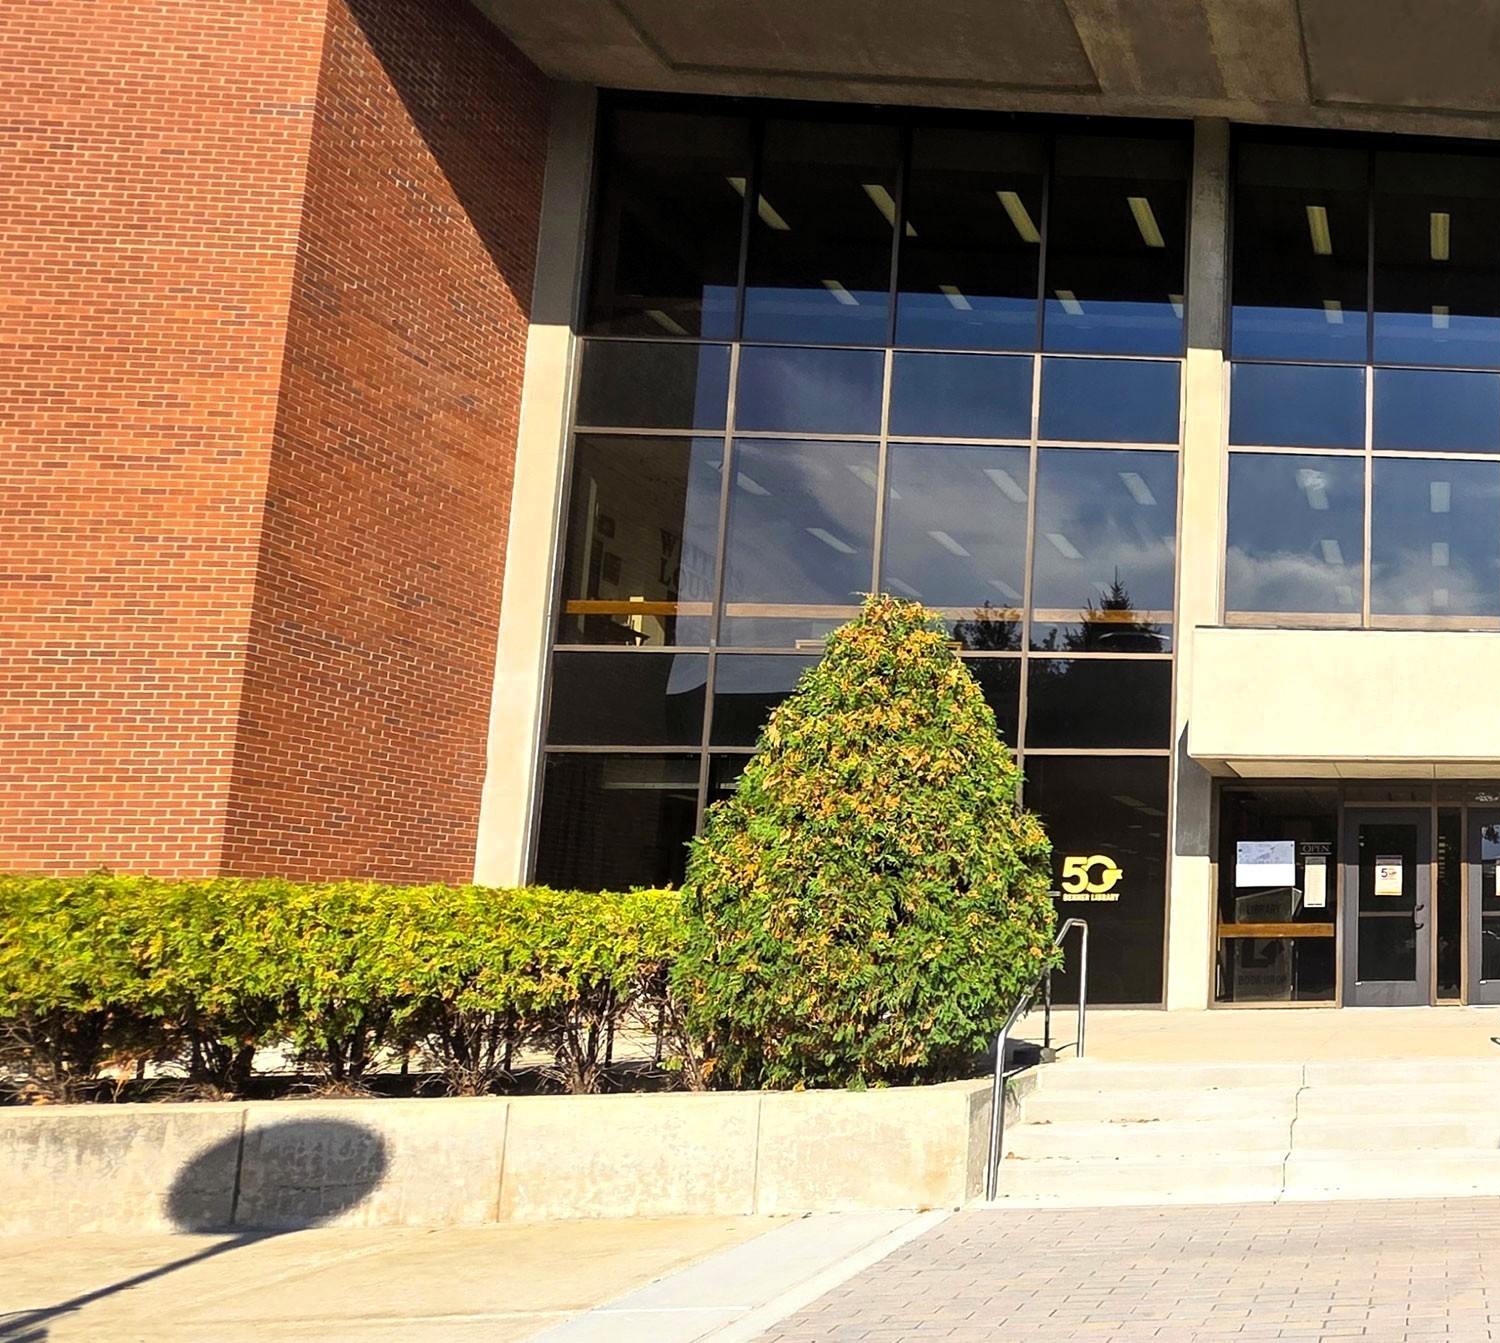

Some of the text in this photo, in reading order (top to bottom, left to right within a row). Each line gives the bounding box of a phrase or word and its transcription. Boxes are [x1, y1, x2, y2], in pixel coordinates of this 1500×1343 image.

[1302, 844, 1330, 852] OPEN
[1061, 854, 1124, 894] 50
[1246, 904, 1281, 915] LIBRARY
[1238, 974, 1287, 986] BOOK DROP
